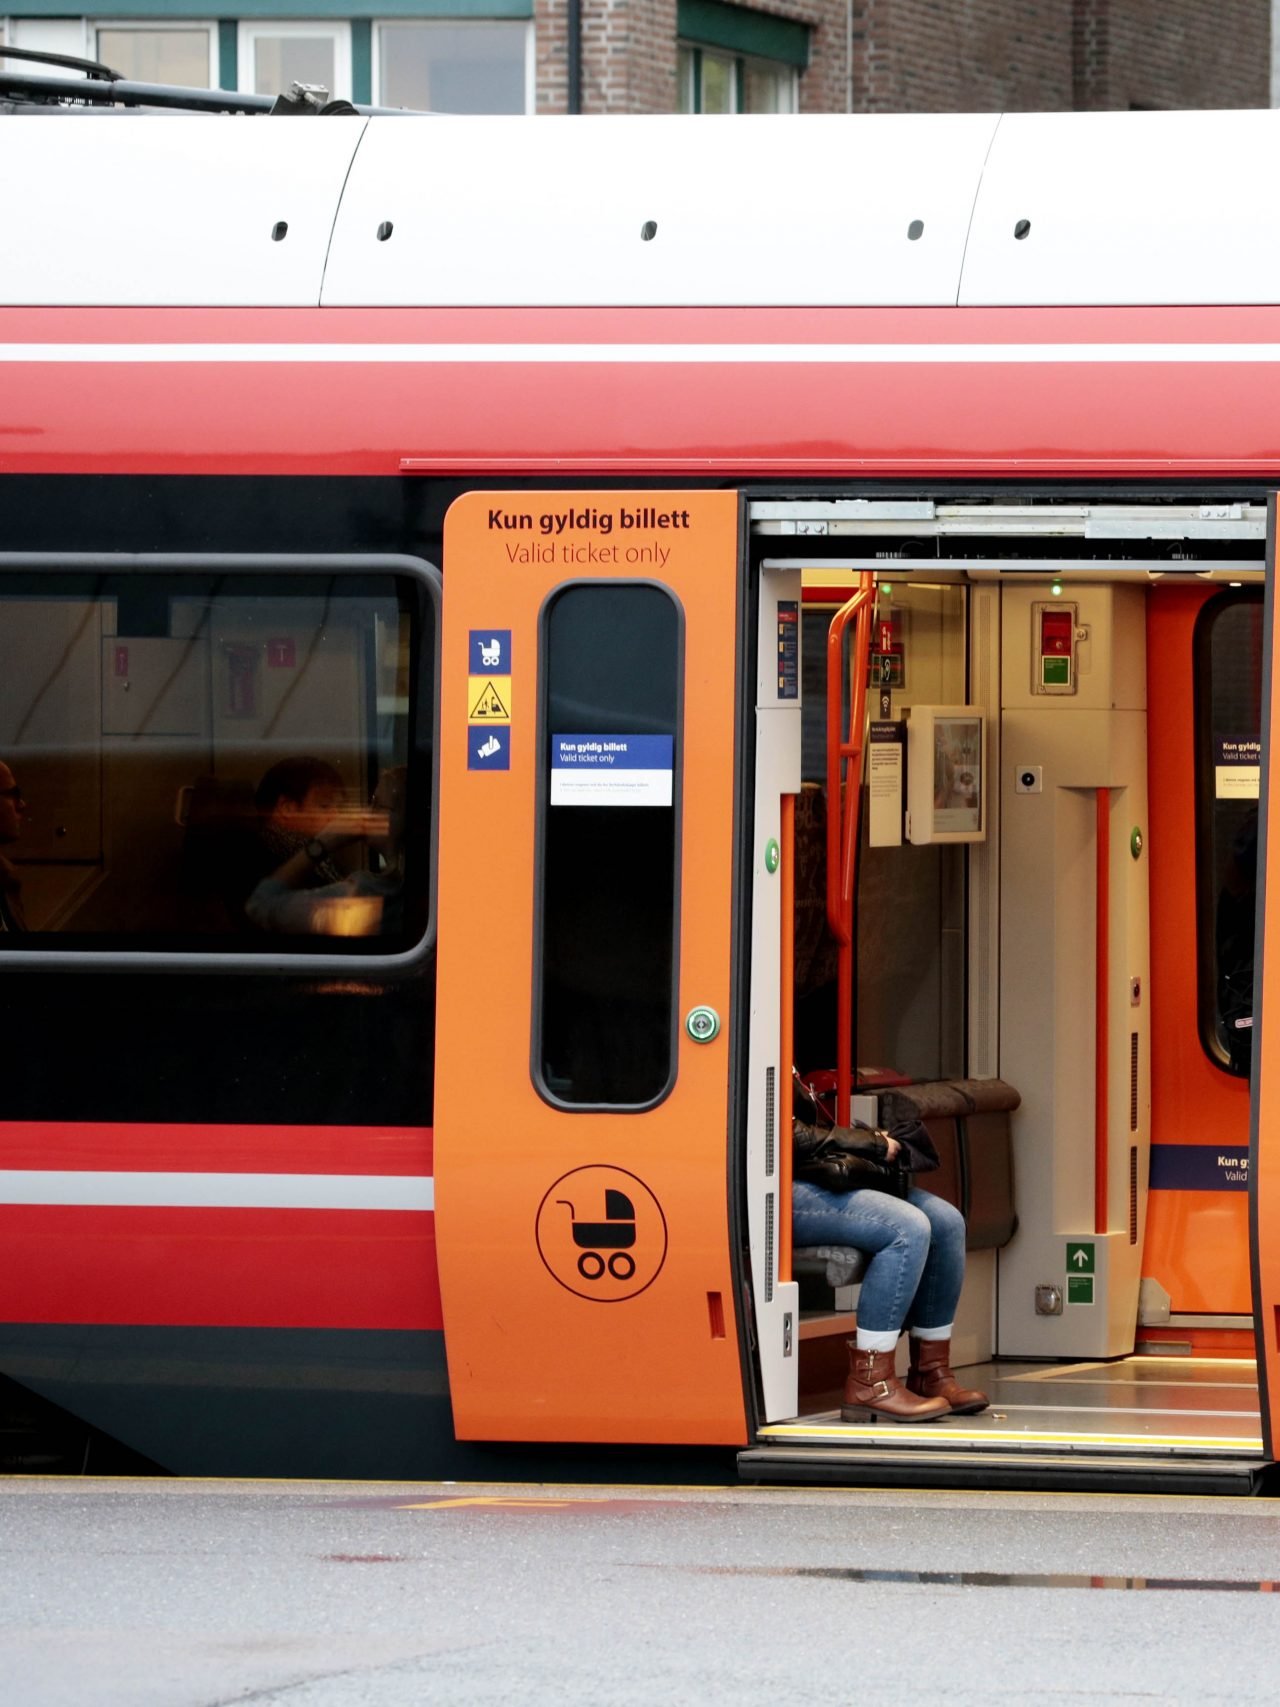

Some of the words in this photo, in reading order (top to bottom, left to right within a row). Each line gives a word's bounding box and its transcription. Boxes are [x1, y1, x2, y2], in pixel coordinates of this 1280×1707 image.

[488, 509, 533, 529] Kun
[539, 508, 613, 535] gyldig
[620, 508, 690, 529] billett
[505, 542, 556, 563] Valid
[562, 542, 619, 563] ticket
[625, 541, 671, 568] only
[560, 742, 576, 751] Kun
[577, 742, 602, 753] gyldig
[603, 742, 627, 752] billett
[1223, 742, 1237, 750] Kun
[1238, 742, 1261, 752] gyldig
[560, 753, 577, 762] Valid
[578, 753, 598, 763] ticket
[599, 753, 615, 764] only
[1240, 752, 1257, 760] ticket
[1217, 1156, 1238, 1166] Kun
[1225, 1170, 1248, 1181] Valid
